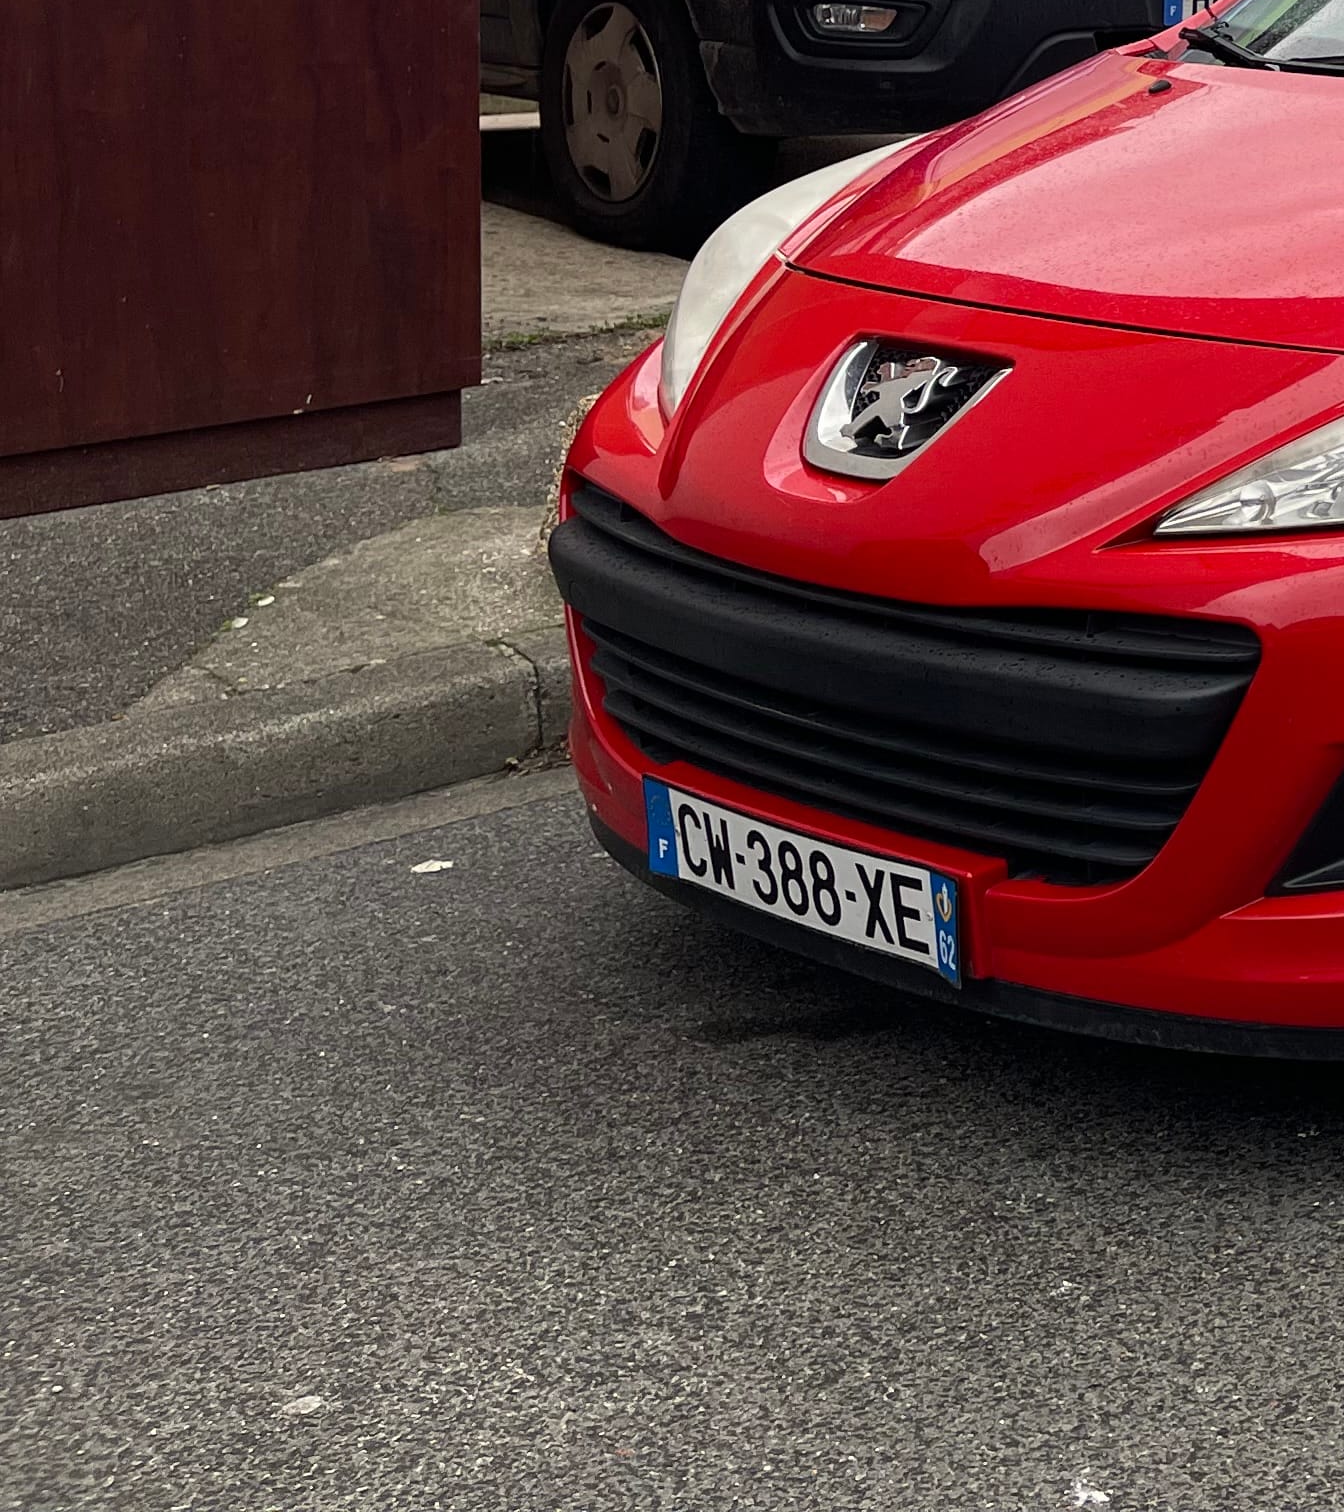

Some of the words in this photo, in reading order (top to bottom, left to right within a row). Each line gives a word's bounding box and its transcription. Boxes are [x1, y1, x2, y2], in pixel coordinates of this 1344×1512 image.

[658, 838, 668, 859] F
[678, 803, 931, 955] CW-388-XE
[939, 930, 957, 971] 62
